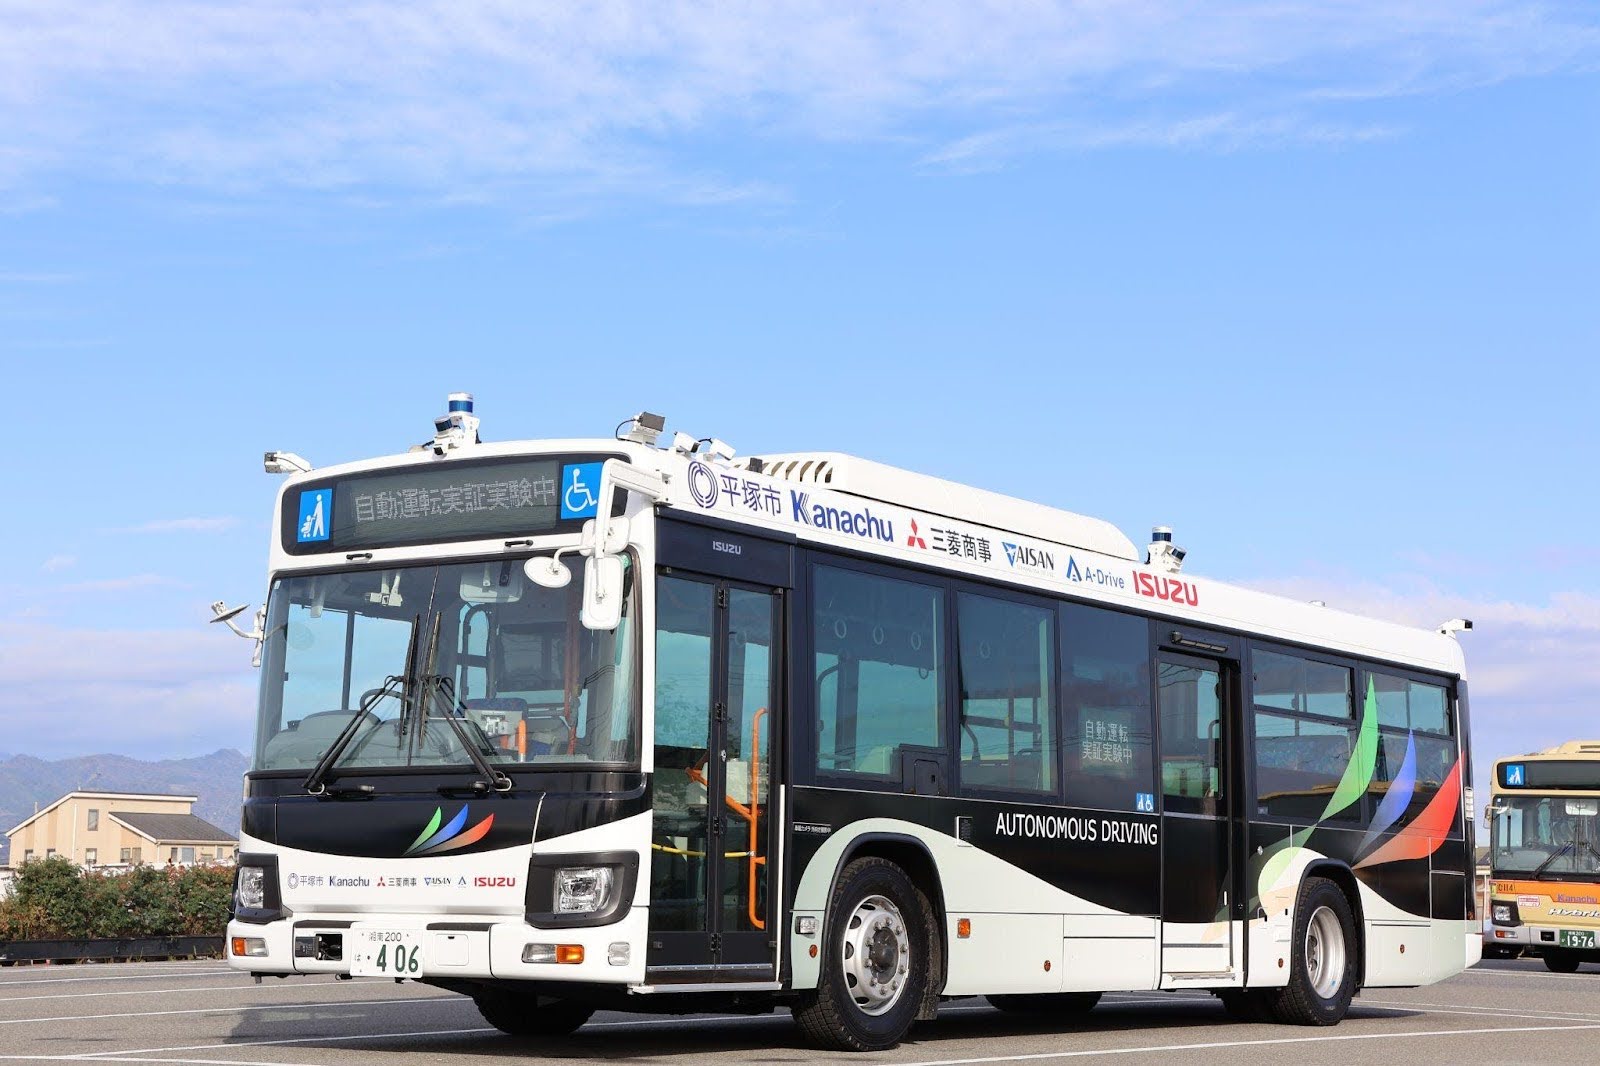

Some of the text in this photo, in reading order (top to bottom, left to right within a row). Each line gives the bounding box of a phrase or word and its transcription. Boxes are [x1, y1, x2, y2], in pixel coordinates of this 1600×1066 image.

[355, 476, 556, 522] 自動運転実証実験中
[720, 474, 781, 517] 平塚市
[790, 489, 894, 542] Kanachu
[712, 540, 742, 555] ISUZU
[930, 527, 992, 563] 三菱商事
[1085, 566, 1125, 589] A-Drive
[1132, 570, 1199, 607] ISUZU
[1085, 720, 1129, 743] 自動運転
[995, 812, 1158, 845] AUTONOMOUS DRIVING
[300, 875, 324, 887] 平塚市
[329, 876, 370, 887] Kanachu
[388, 877, 417, 887] 三菱商事
[474, 877, 516, 887] ISUZU
[376, 944, 419, 973] 406
